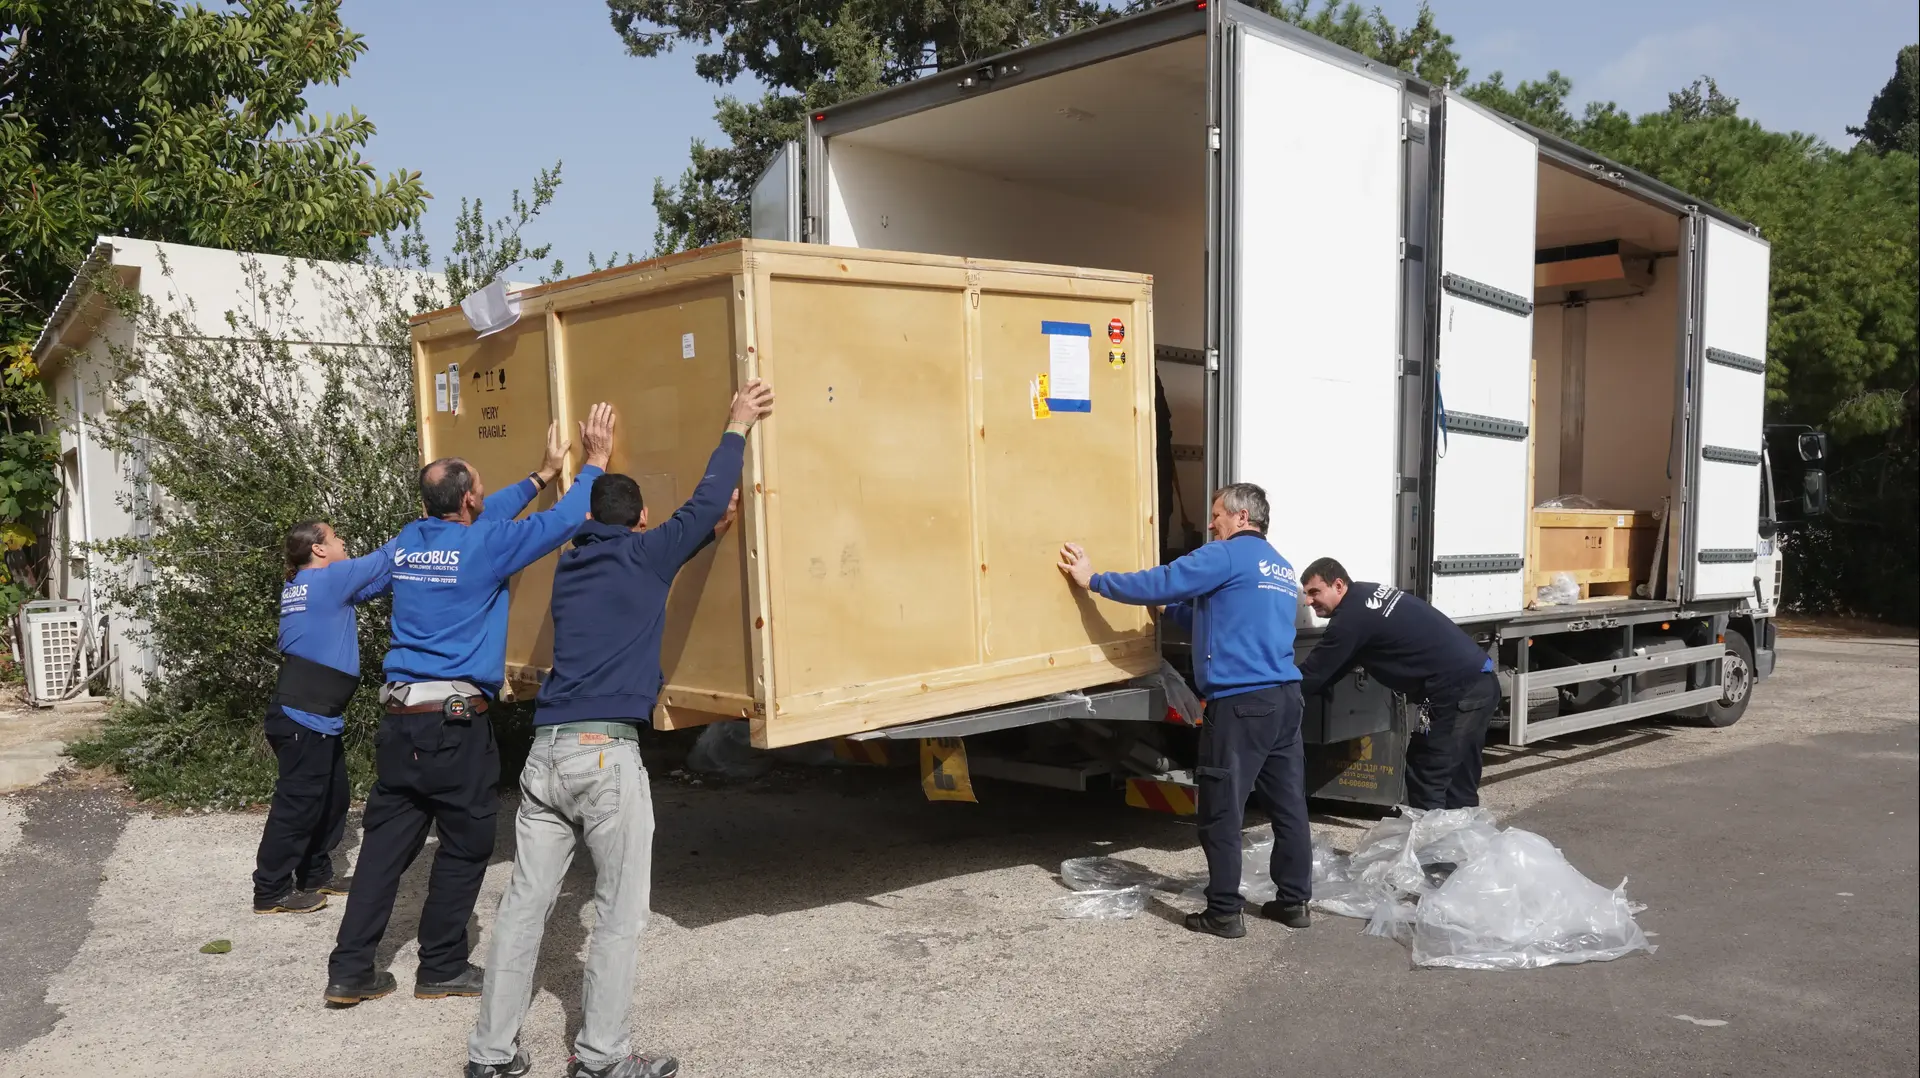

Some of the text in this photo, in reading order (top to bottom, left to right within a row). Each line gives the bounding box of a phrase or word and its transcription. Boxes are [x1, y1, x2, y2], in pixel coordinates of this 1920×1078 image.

[481, 406, 499, 420] VERY
[479, 425, 507, 439] FRAGILE
[407, 550, 460, 565] GLOBUS
[433, 564, 459, 572] LOGISTICS
[1271, 563, 1297, 581] GLOBU
